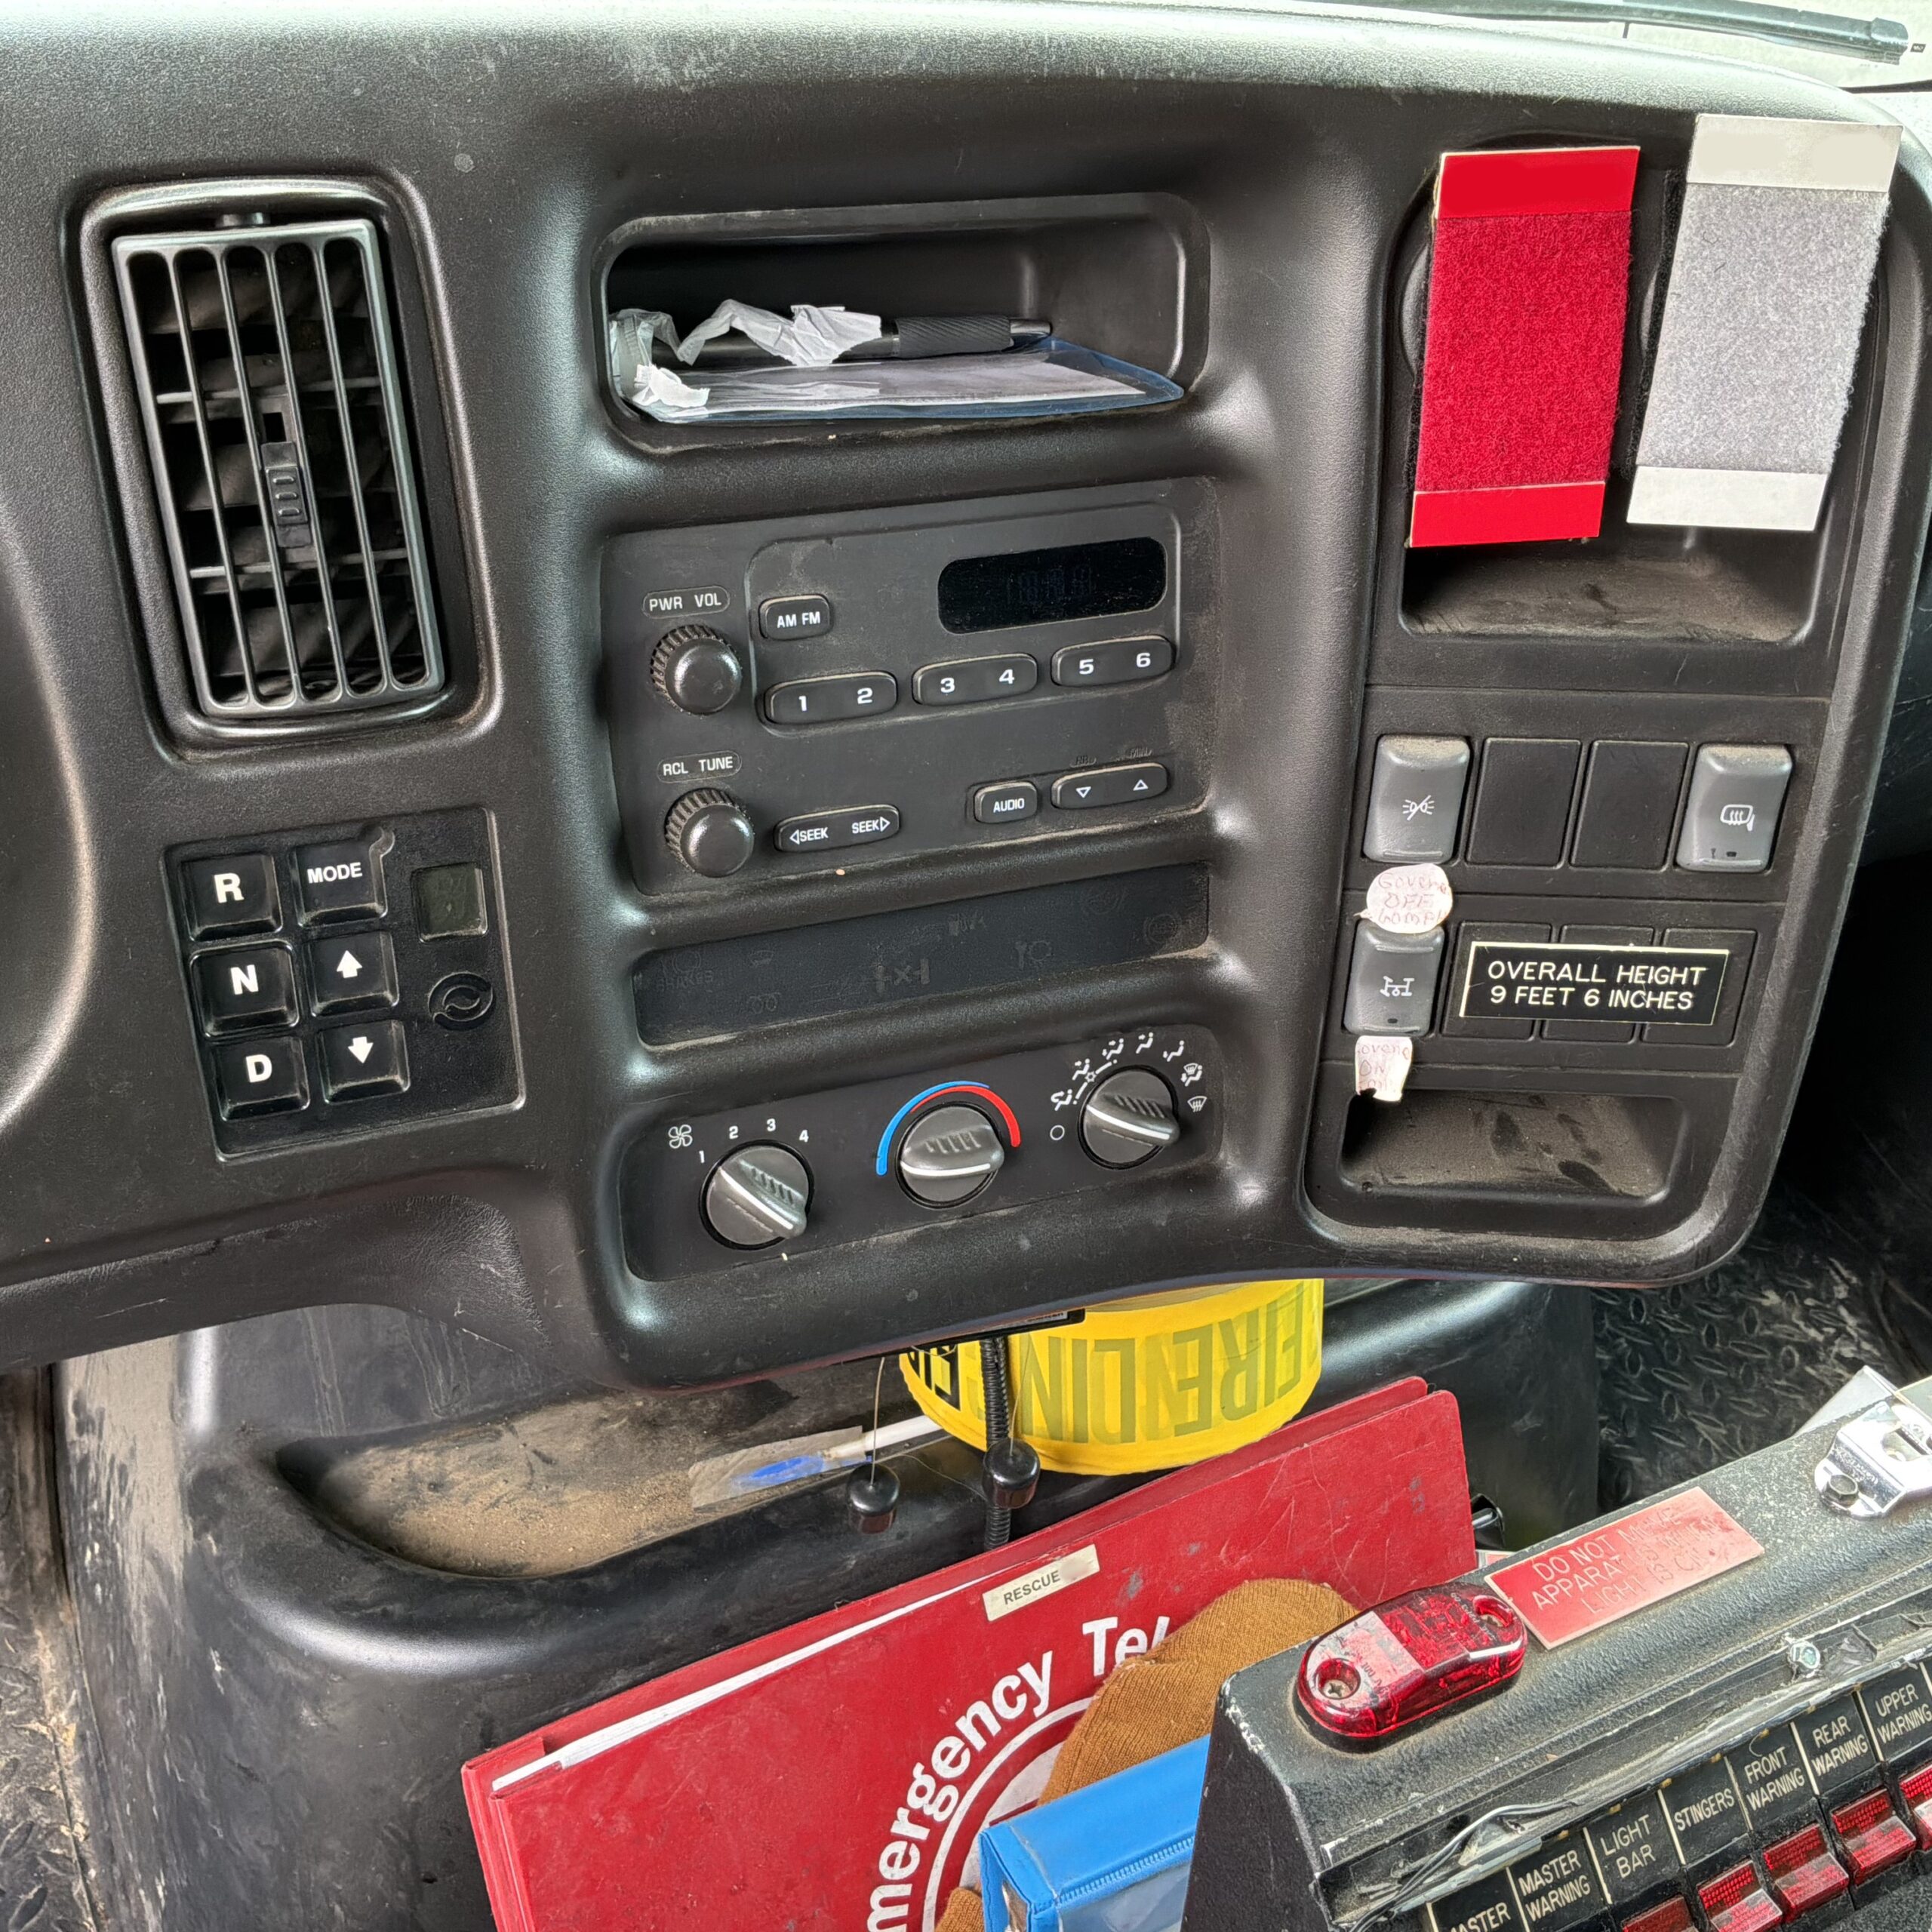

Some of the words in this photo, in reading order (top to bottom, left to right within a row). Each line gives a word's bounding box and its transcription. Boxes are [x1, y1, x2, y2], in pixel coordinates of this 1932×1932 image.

[648, 595, 682, 612] PWR
[694, 592, 722, 608] VOL
[777, 611, 797, 628] AM
[801, 609, 821, 626] FM
[1079, 659, 1094, 675] 5
[1136, 653, 1151, 668] 6
[940, 678, 955, 694] 3
[998, 669, 1015, 685] 4
[798, 695, 808, 712] 1
[857, 688, 872, 705] 2
[662, 760, 688, 777] RCL
[698, 755, 734, 774] TUNE
[993, 797, 1025, 814] AUDIO
[799, 826, 829, 844] SEEK
[851, 819, 880, 835] SEEK
[213, 872, 244, 903] R
[306, 862, 363, 884] MODE
[229, 964, 259, 995] N
[1487, 960, 1606, 983] OVERALL
[1616, 964, 1706, 986] HEIGHT
[1491, 985, 1506, 1004] 9
[1515, 986, 1575, 1006] FEET
[1584, 988, 1600, 1007] 6
[1607, 989, 1694, 1010] INCHES
[245, 1054, 272, 1083] D
[698, 1150, 705, 1164] 1
[728, 1124, 738, 1140] 2
[766, 1118, 776, 1132] 3
[798, 1129, 810, 1143] 4
[1020, 1334, 1137, 1445] LIN
[1533, 1556, 1571, 1582] DO
[1569, 1534, 1619, 1566] NOT
[1004, 1570, 1060, 1605] RESCUE
[1531, 1547, 1659, 1611] APPARATUS
[1581, 1575, 1646, 1614] LIGHT
[1875, 1683, 1918, 1718] UPPER
[1813, 1715, 1851, 1748] REAR
[1877, 1703, 1932, 1744] WARNING
[1744, 1746, 1789, 1784] FRONT
[1812, 1734, 1869, 1776] WARNING
[1747, 1767, 1805, 1811] WARNING
[1674, 1789, 1734, 1832] STINGERS
[1601, 1814, 1650, 1857] LIGHT
[1518, 1850, 1582, 1897] MASTER
[1617, 1844, 1656, 1879] BAR
[1525, 1875, 1591, 1921] WARNING
